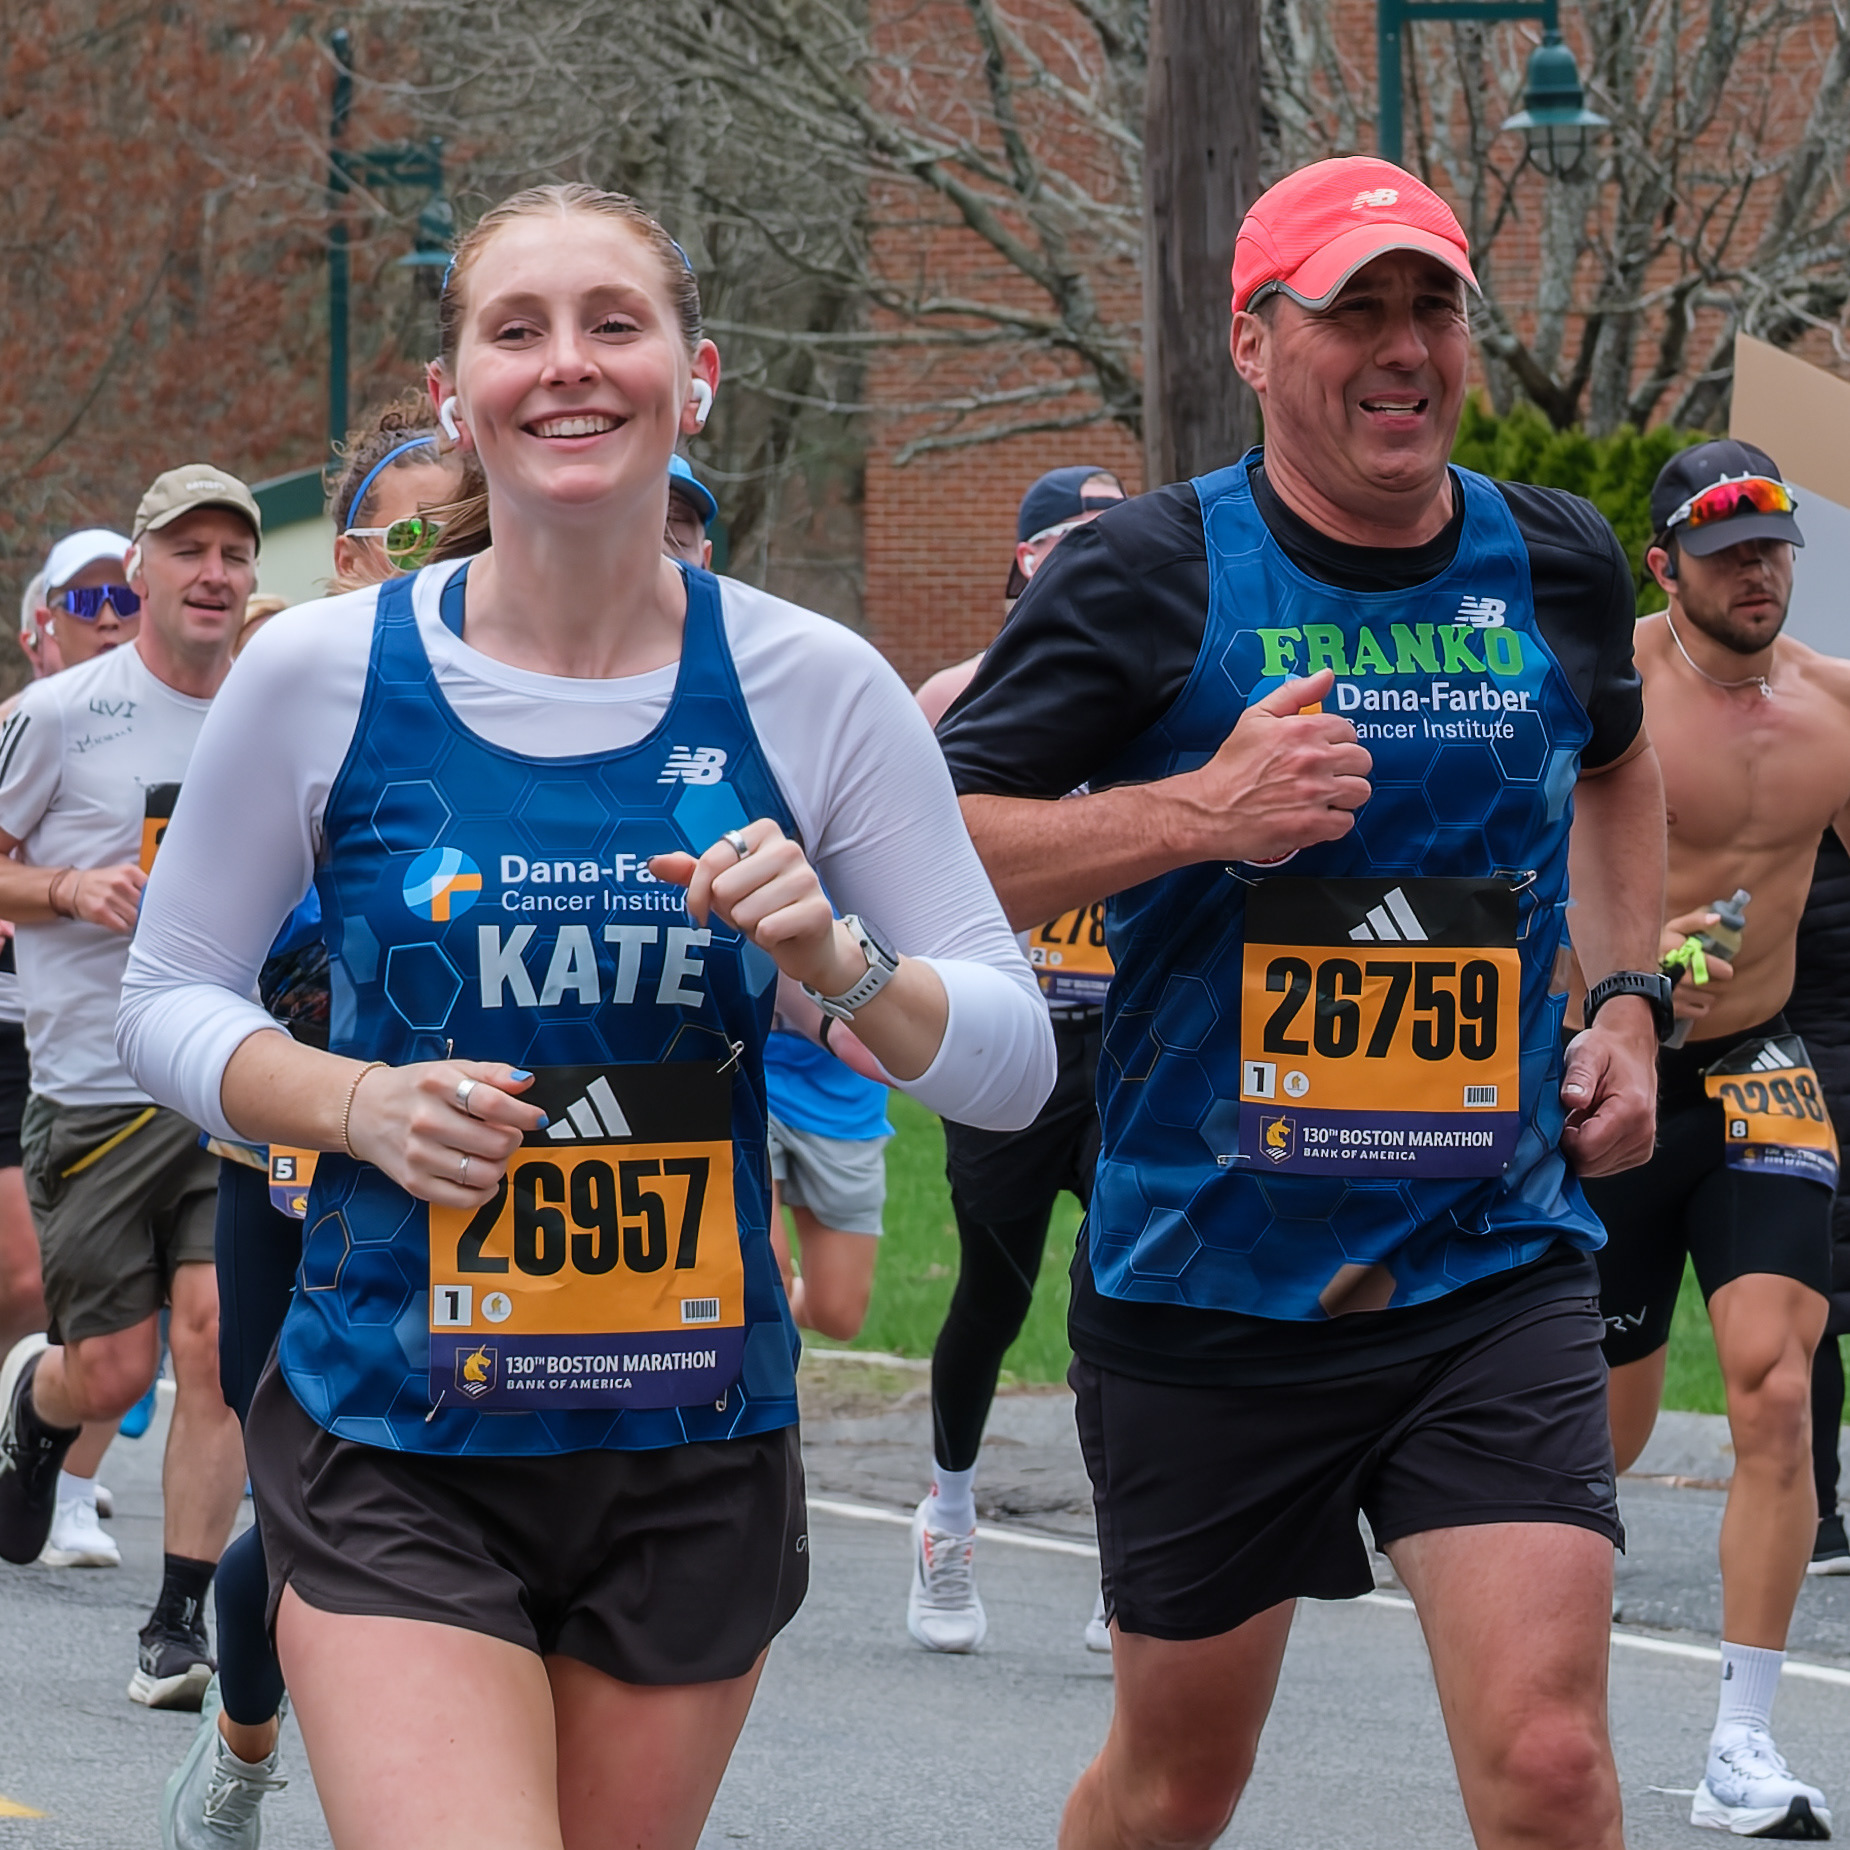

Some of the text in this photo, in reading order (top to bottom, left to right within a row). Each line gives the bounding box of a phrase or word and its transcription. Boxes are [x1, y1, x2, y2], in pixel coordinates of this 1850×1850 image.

[1256, 623, 1525, 676] FRANKO
[1337, 682, 1530, 712] Dana-Farber
[1423, 718, 1514, 739] Institute
[500, 853, 666, 884] Dana-Fa
[501, 889, 685, 912] Cancer Institu
[477, 924, 712, 1009] KATE
[1263, 956, 1499, 1061] 26759
[1252, 1066, 1265, 1093] 1
[1340, 1129, 1404, 1146] BOSTON
[1408, 1131, 1493, 1147] MARATHON
[1732, 1120, 1746, 1138] 8
[1303, 1147, 1416, 1161] BANK OF AMERICA
[275, 1158, 293, 1179] 5
[457, 1157, 710, 1276] 26957
[445, 1290, 459, 1321] 1
[505, 1350, 716, 1375] 130TH BOSTON MARATHON
[506, 1378, 633, 1390] BANK OF AMERICA
